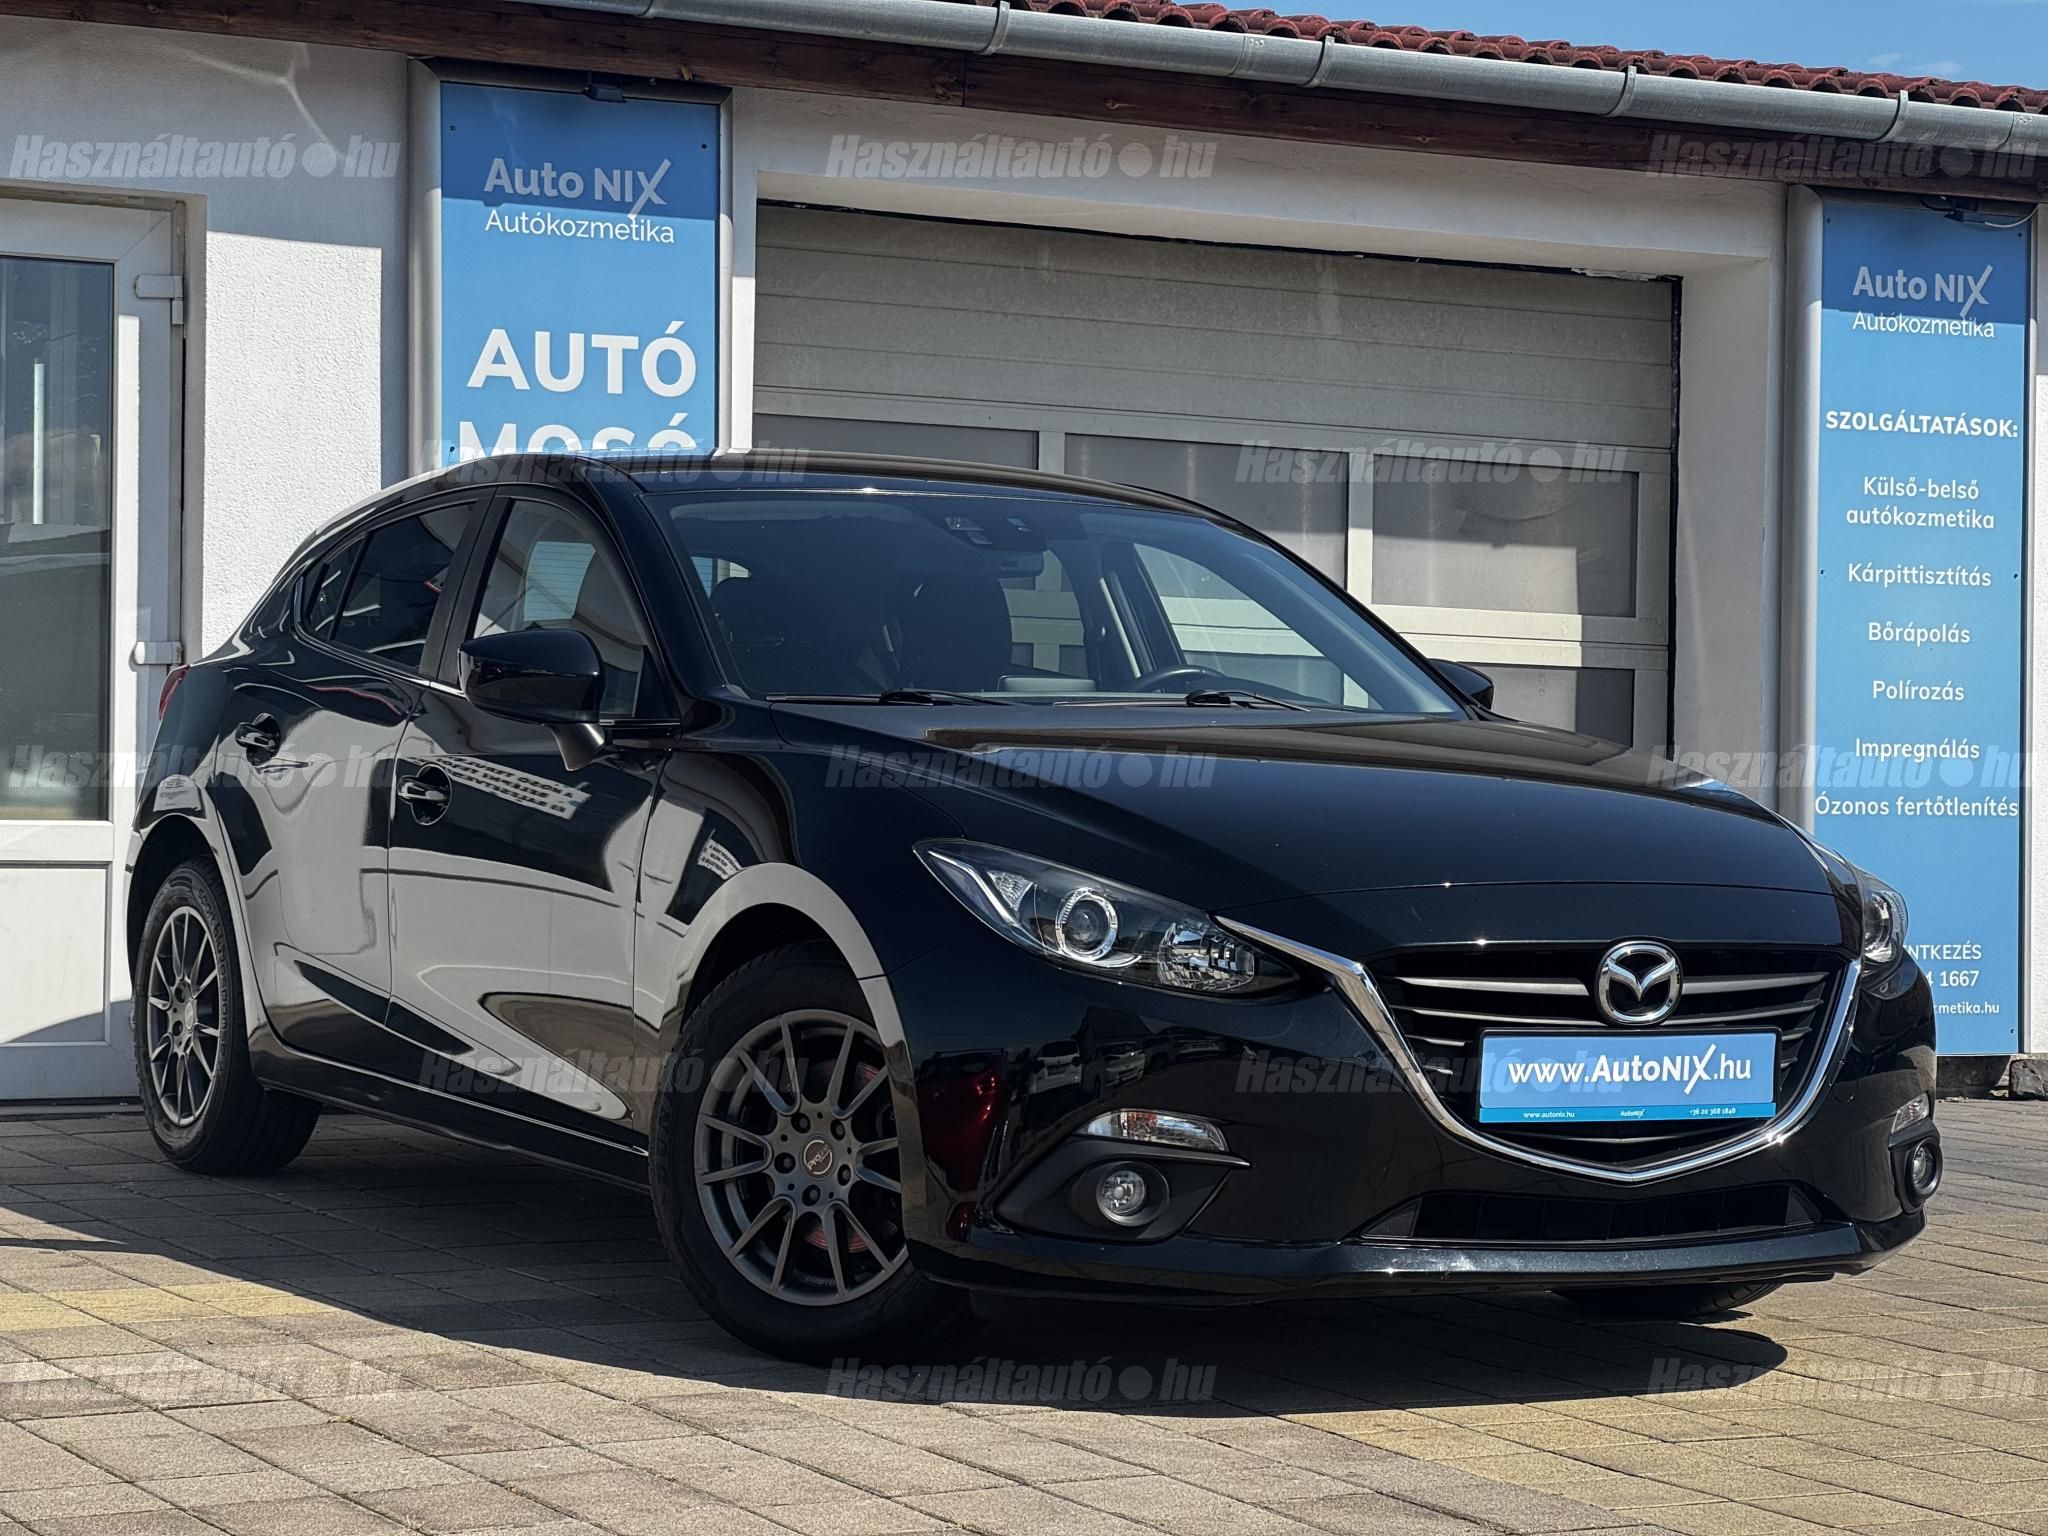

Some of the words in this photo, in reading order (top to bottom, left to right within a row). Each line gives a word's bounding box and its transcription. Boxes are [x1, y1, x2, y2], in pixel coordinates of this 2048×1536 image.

[484, 157, 584, 198] Auto
[594, 158, 672, 219] NIX
[485, 209, 674, 244] Autókozmetika
[1852, 266, 1927, 301] Auto
[1935, 264, 1993, 318] NIX
[1852, 310, 1995, 338] Autókozmetika
[467, 321, 697, 398] AUTÓ
[1826, 409, 2018, 438] SZOLGÁLTATÁSOK:
[1864, 476, 1979, 500] Külső-belső
[1846, 505, 1995, 529] autókozmetika
[1849, 562, 1991, 588] Kárpittisztítás
[1868, 621, 1970, 647] Bőrápolás
[1872, 680, 1965, 701] Polírozás
[1856, 738, 1980, 763] Impregnálás
[1815, 791, 1889, 816] Ózonos
[1896, 796, 2019, 817] fertőtlenítés
[1903, 941, 1981, 960] NTKEZÉS
[1940, 970, 1980, 987] 1667
[1508, 1043, 1751, 1095] www.AutoNIX.hu
[1523, 1110, 1575, 1118] www.autonix.hu
